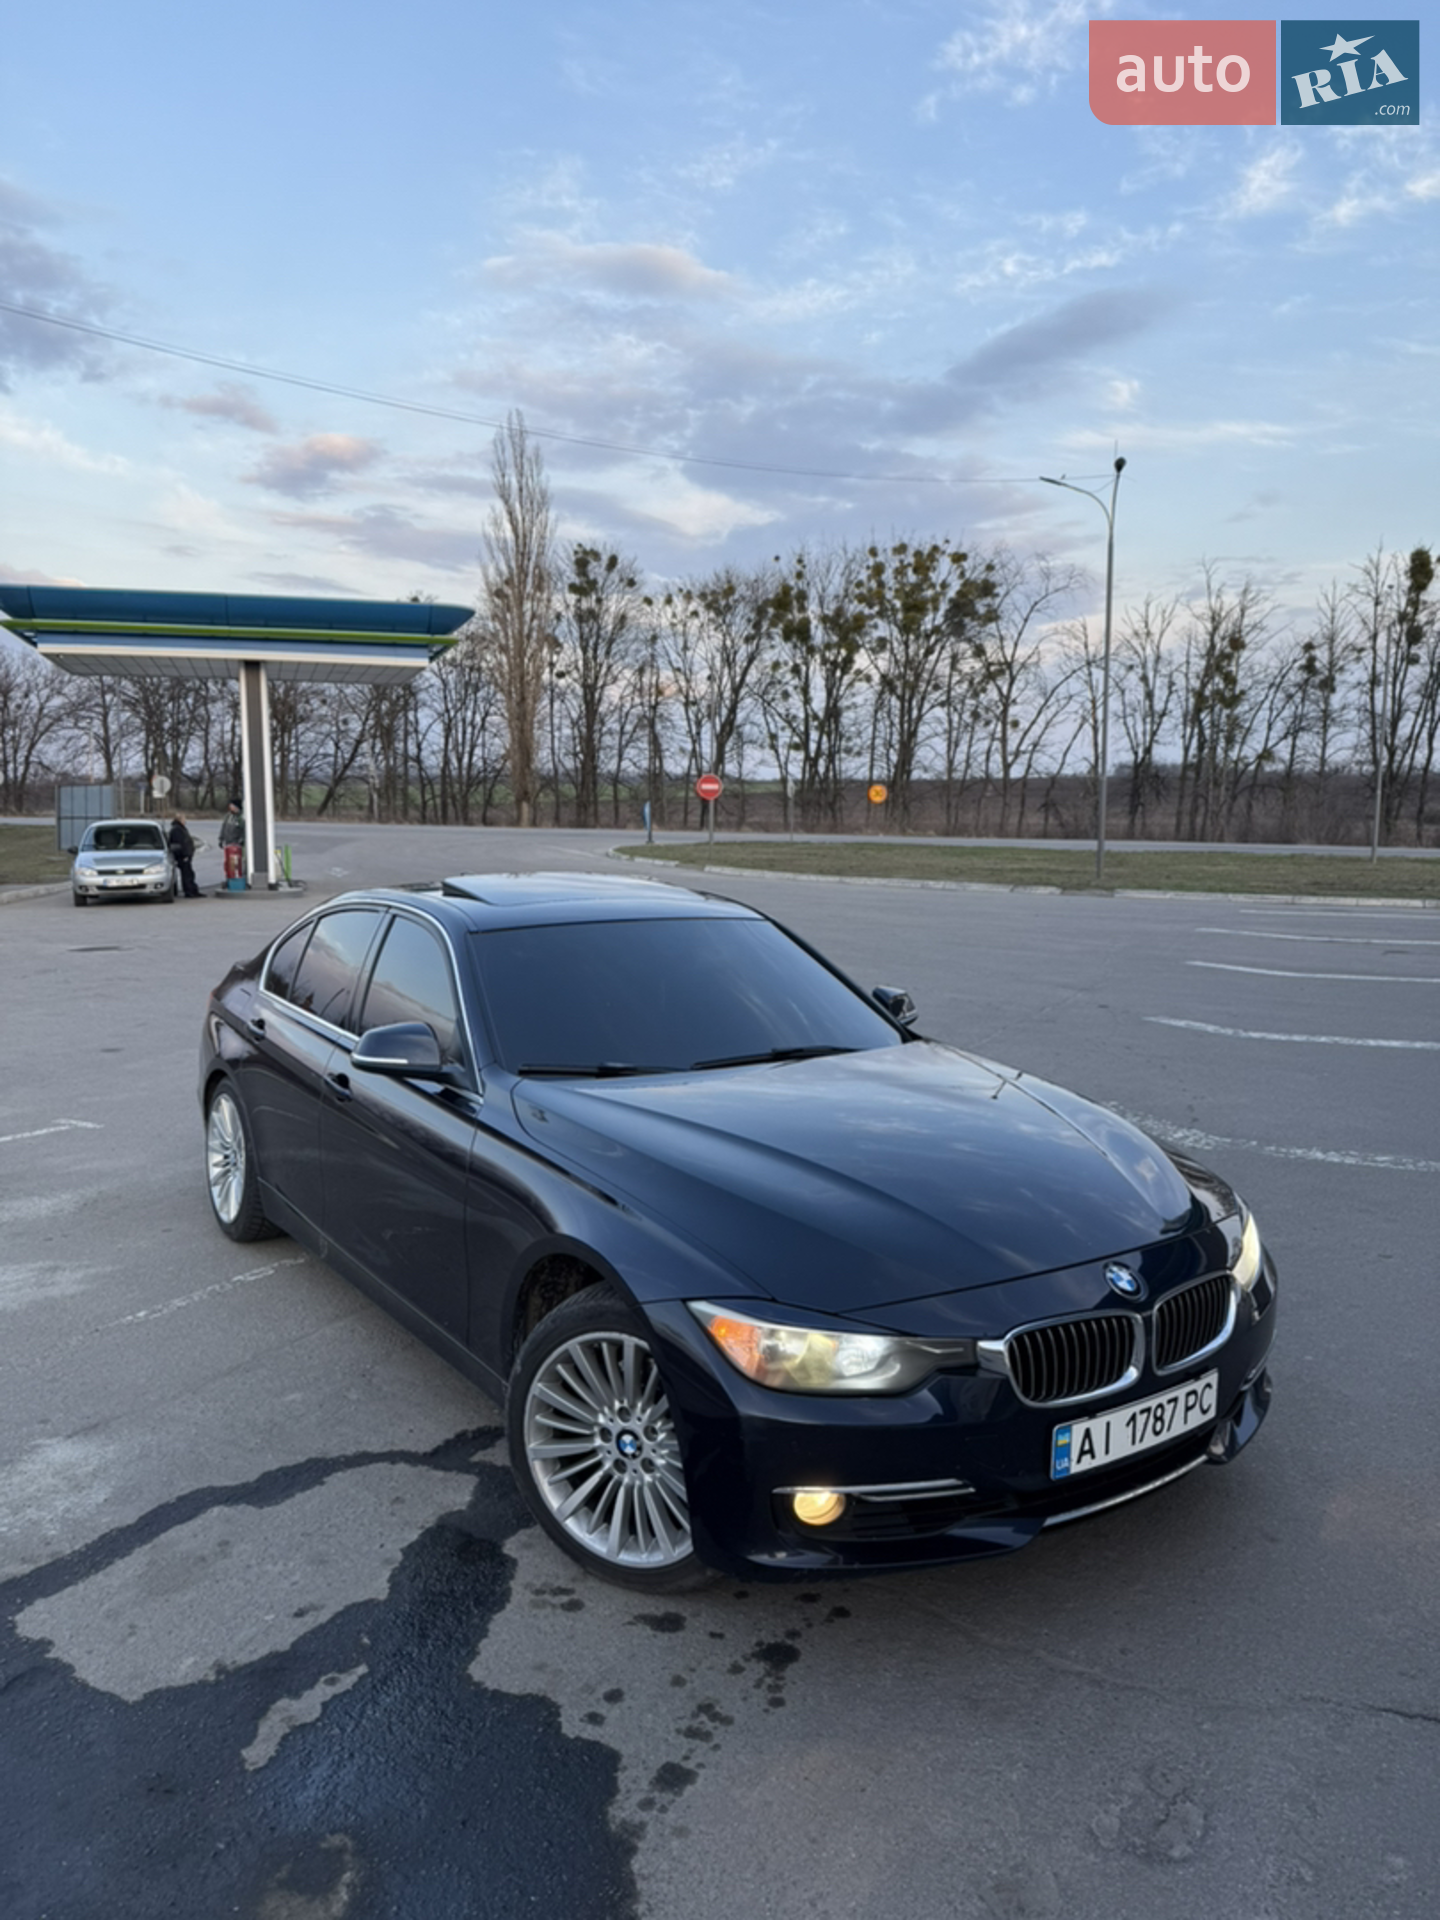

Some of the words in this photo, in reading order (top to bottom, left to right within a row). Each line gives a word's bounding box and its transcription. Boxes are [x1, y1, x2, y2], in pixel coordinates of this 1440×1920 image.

[1077, 1421, 1110, 1464] AI
[1125, 1396, 1179, 1446] 1787
[1184, 1383, 1213, 1425] PC
[1056, 1457, 1070, 1471] UA
